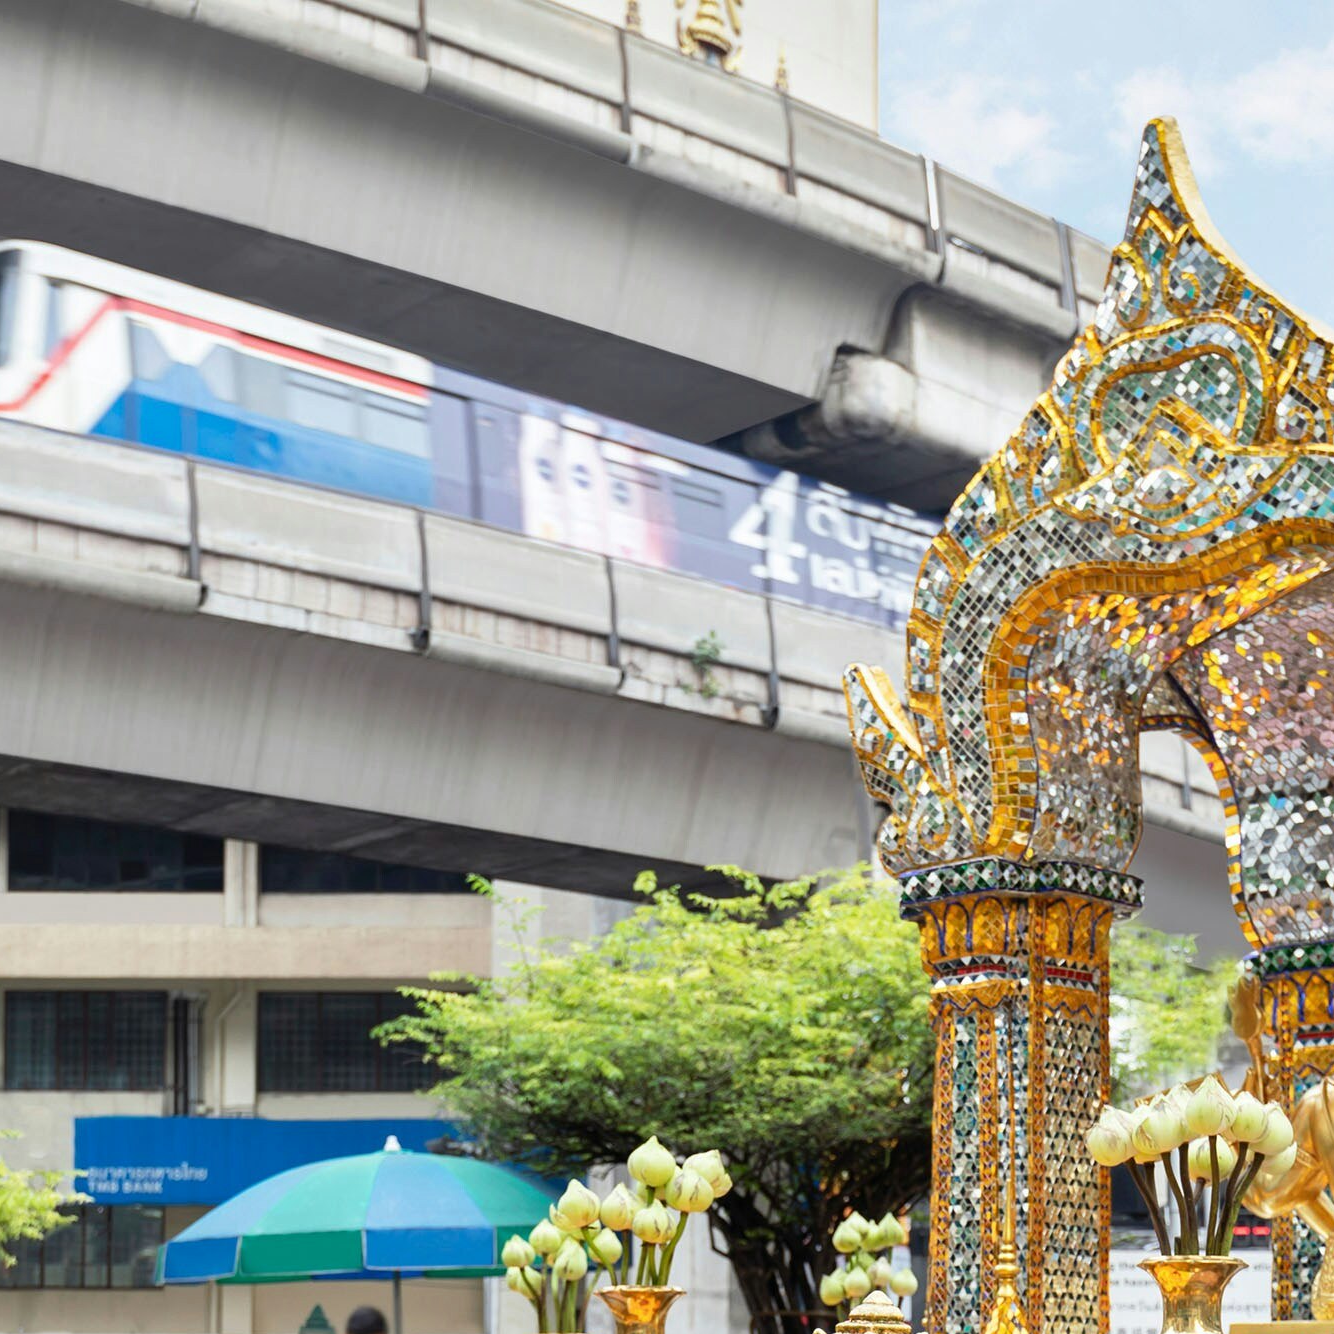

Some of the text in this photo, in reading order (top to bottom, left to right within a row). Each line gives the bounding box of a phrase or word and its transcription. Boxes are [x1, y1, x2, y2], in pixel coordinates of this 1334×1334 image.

[728, 470, 808, 585] 4
[88, 1180, 163, 1193] TMB BANK
